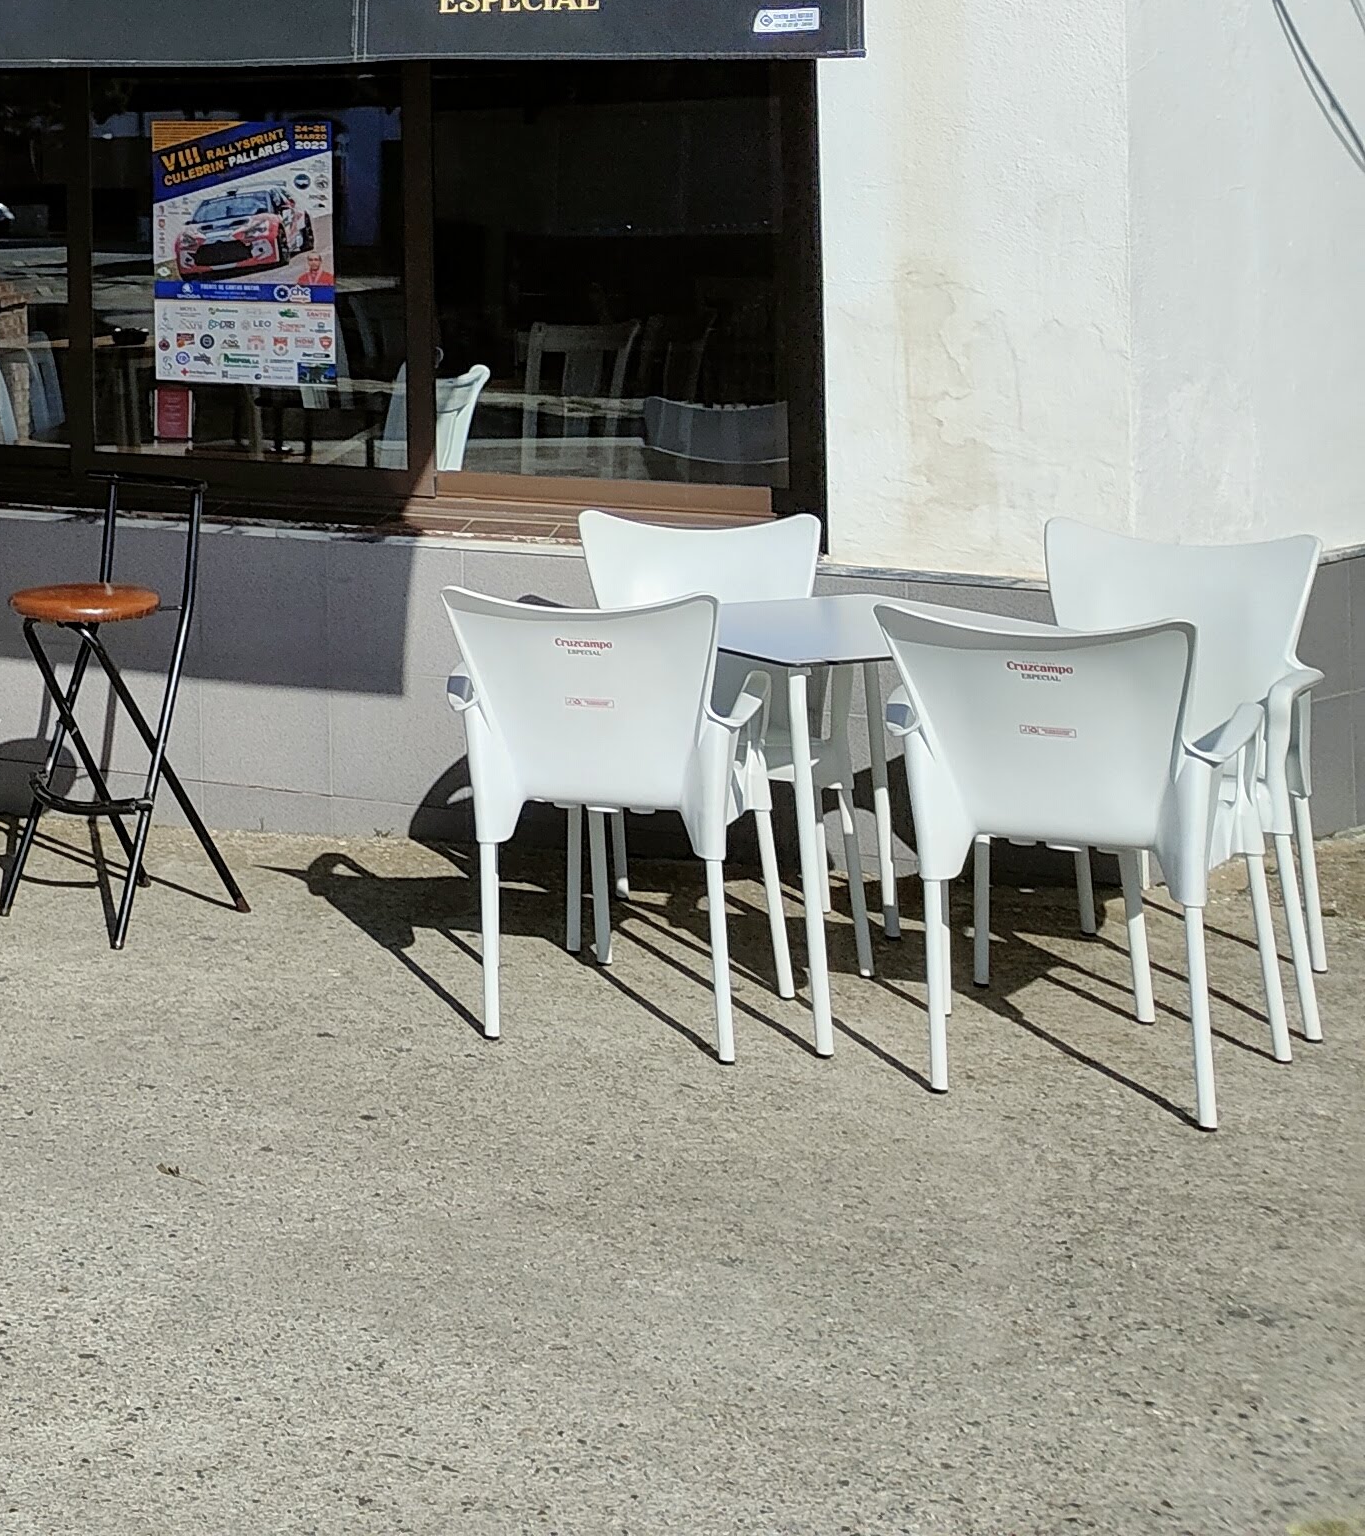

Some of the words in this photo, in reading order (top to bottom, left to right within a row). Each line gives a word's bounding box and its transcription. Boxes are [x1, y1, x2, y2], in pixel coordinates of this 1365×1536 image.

[161, 146, 201, 172] VIII
[206, 128, 284, 161] RALLYSPRINT
[294, 141, 327, 150] 2023
[253, 320, 272, 328] LEO
[554, 637, 613, 650] Cruzcampo
[1006, 660, 1074, 675] Cruzcampo
